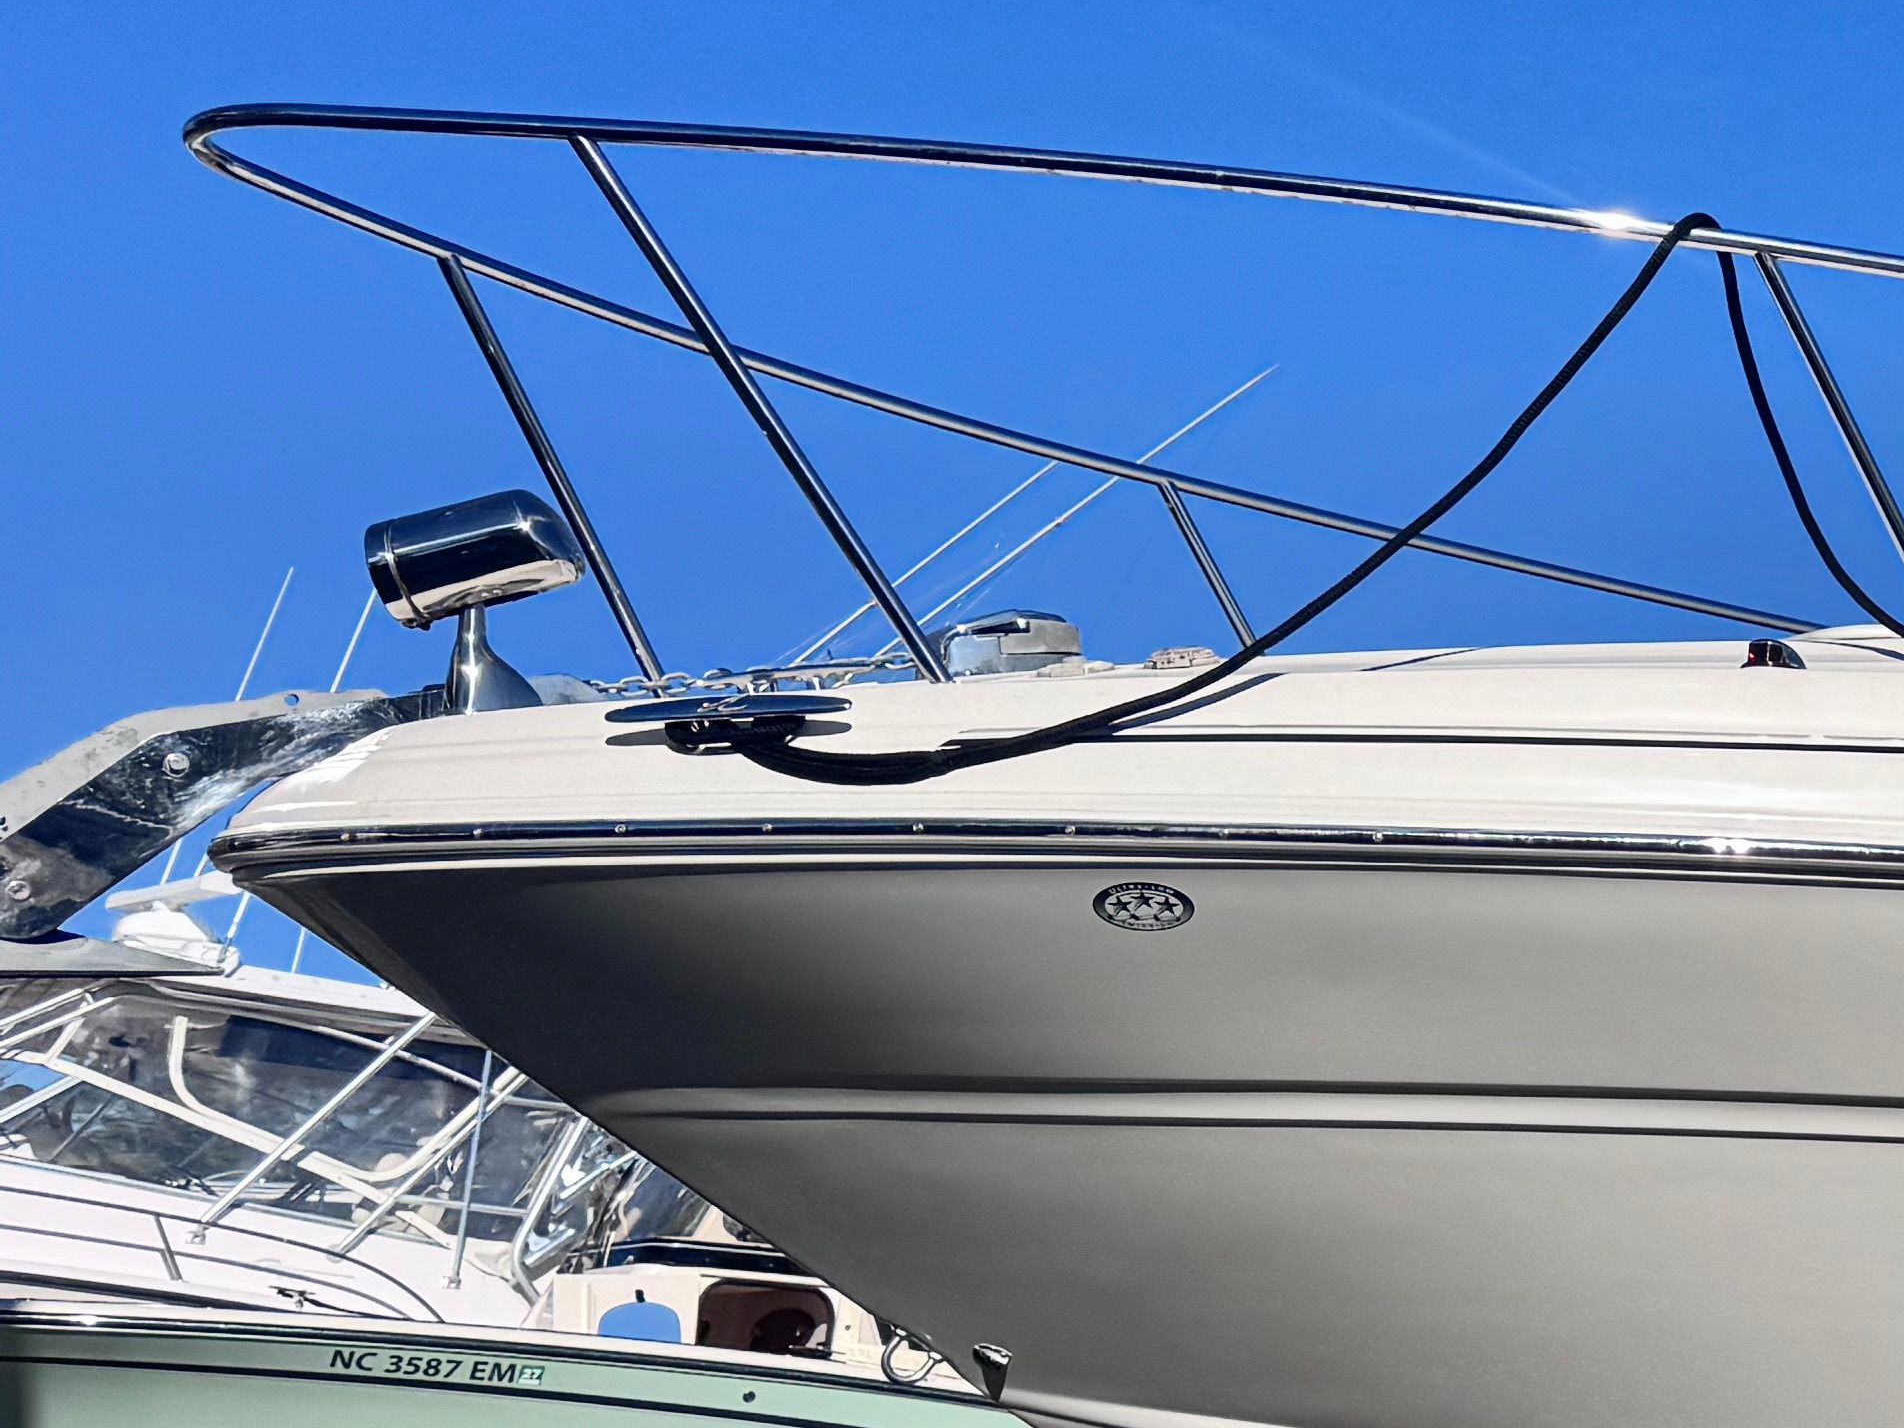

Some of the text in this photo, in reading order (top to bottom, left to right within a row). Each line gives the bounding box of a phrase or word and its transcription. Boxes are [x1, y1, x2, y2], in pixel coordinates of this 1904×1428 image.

[329, 1349, 518, 1384] NC 3587 EM
